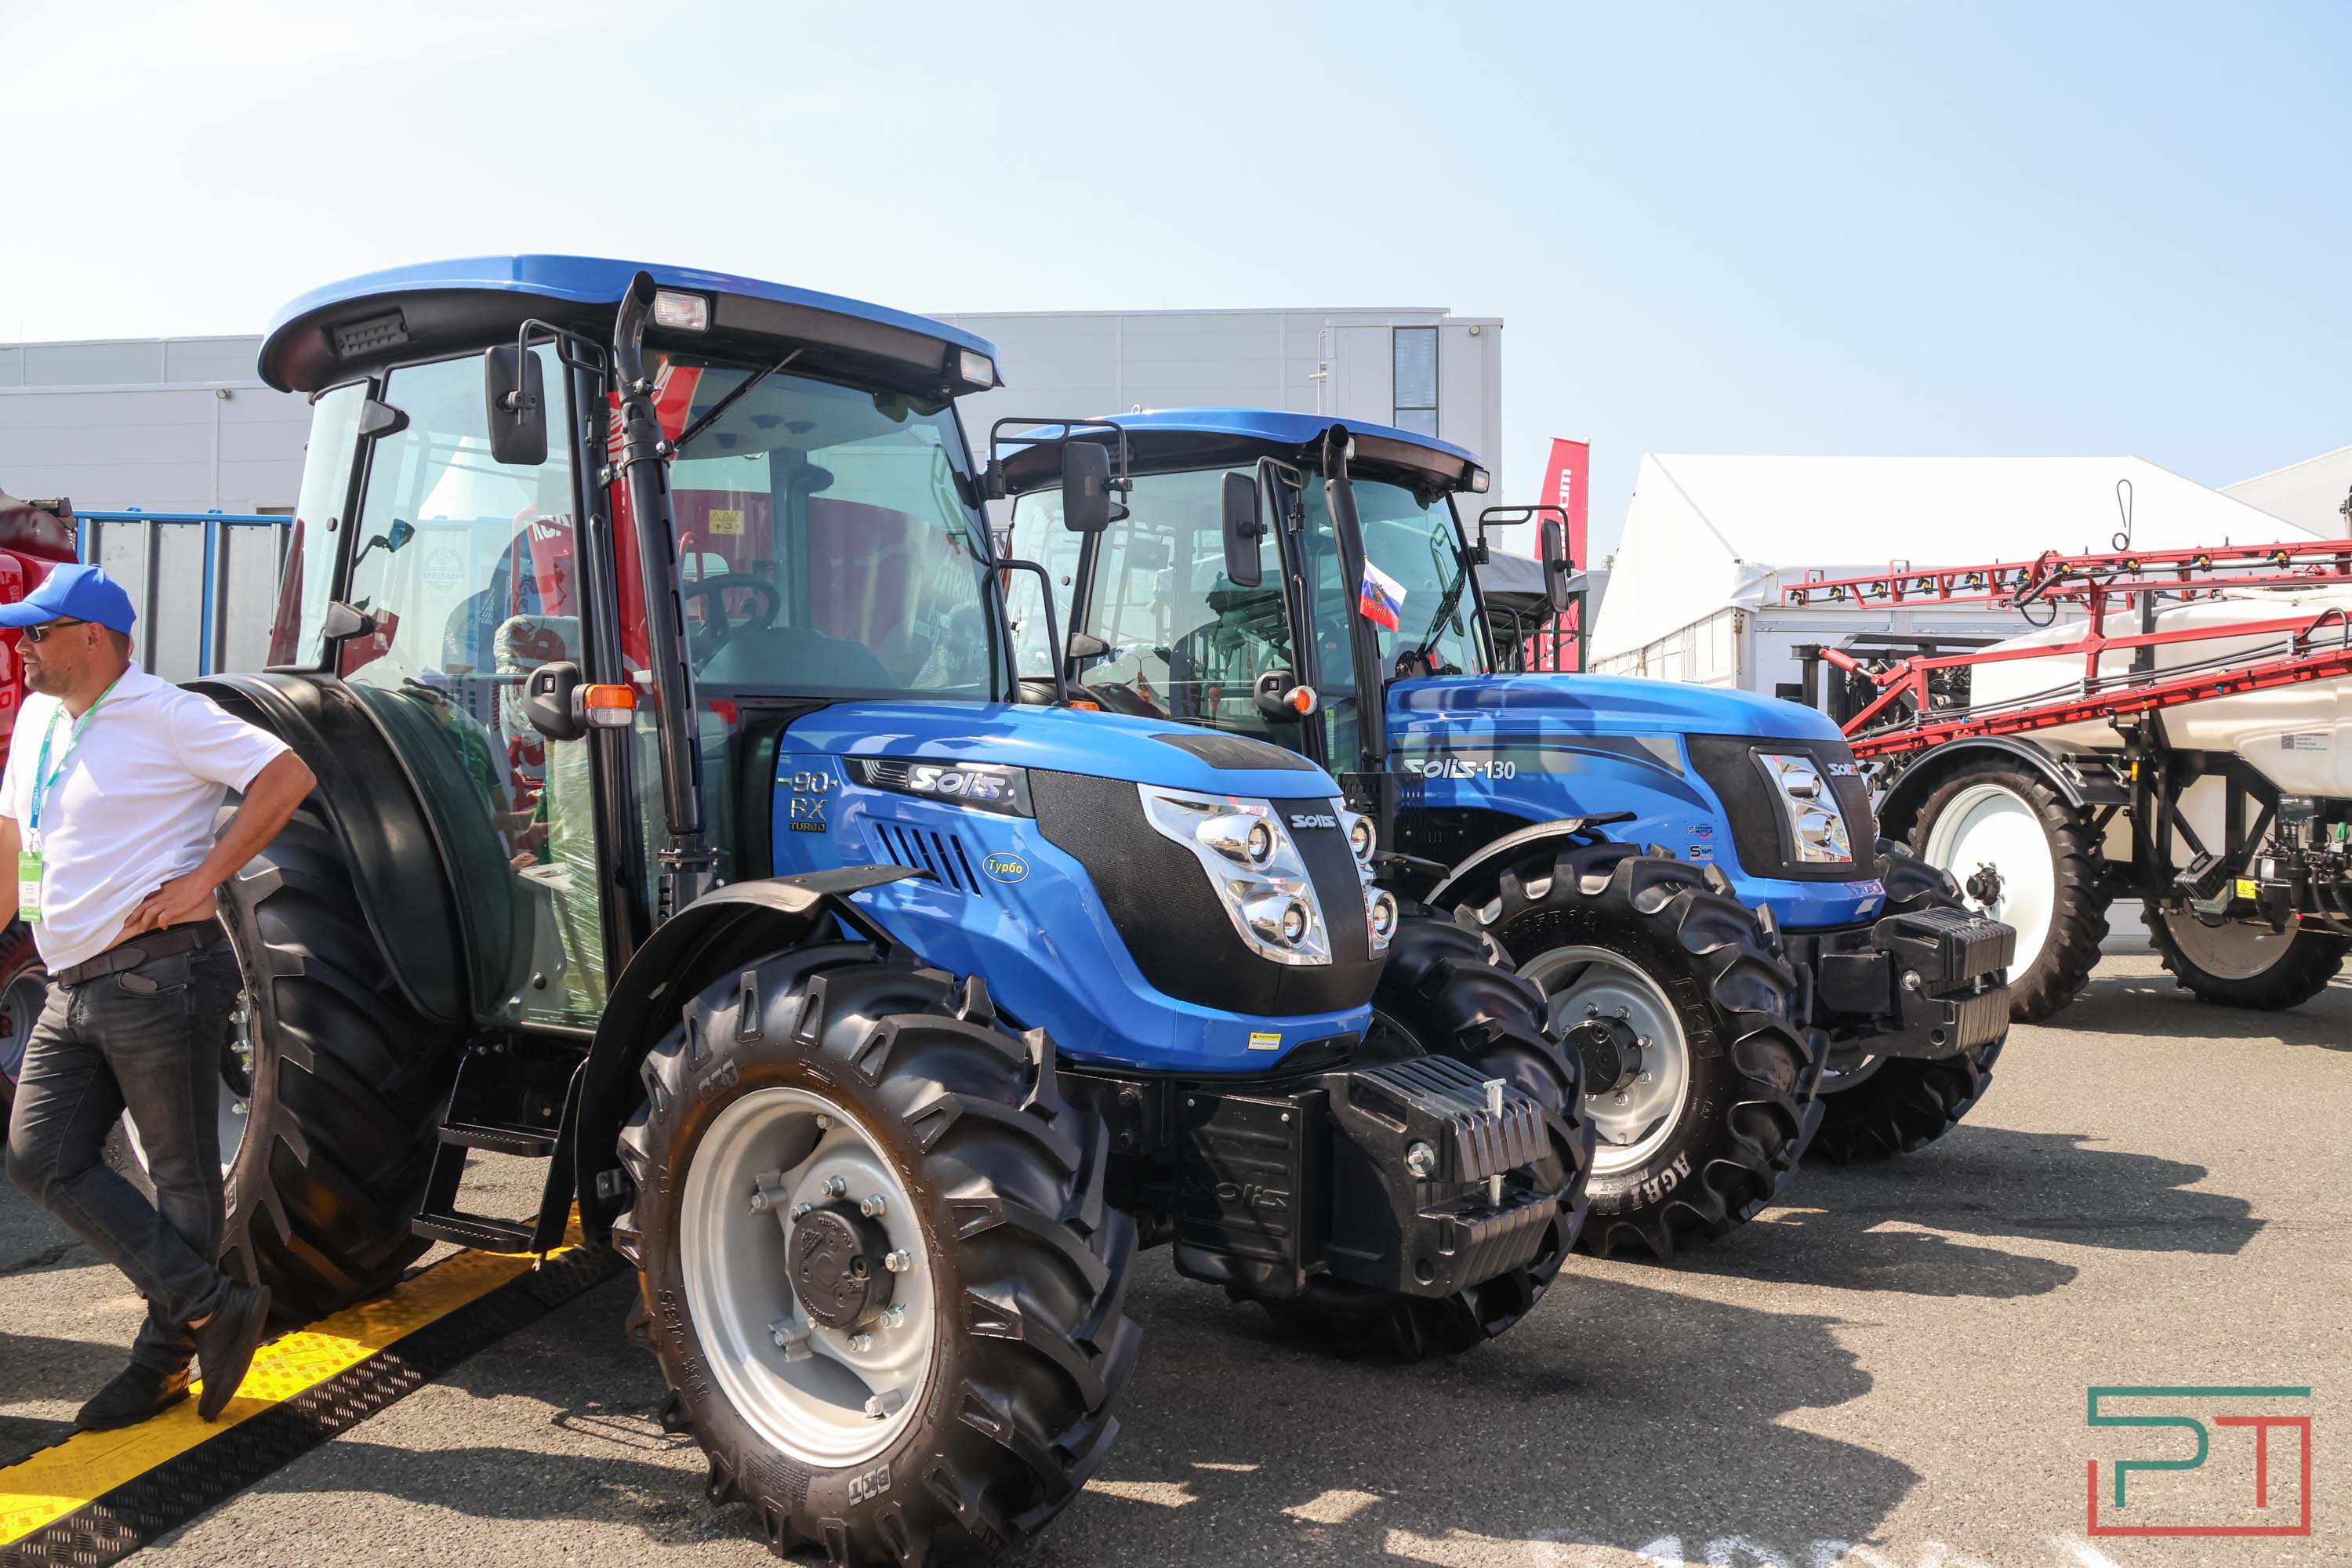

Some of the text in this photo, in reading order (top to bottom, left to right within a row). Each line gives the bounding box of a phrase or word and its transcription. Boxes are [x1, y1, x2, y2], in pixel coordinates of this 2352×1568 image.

[790, 797, 828, 821] RX
[789, 822, 827, 833] TURBO
[989, 858, 1023, 875] Турбо
[848, 1464, 891, 1507] BKT
